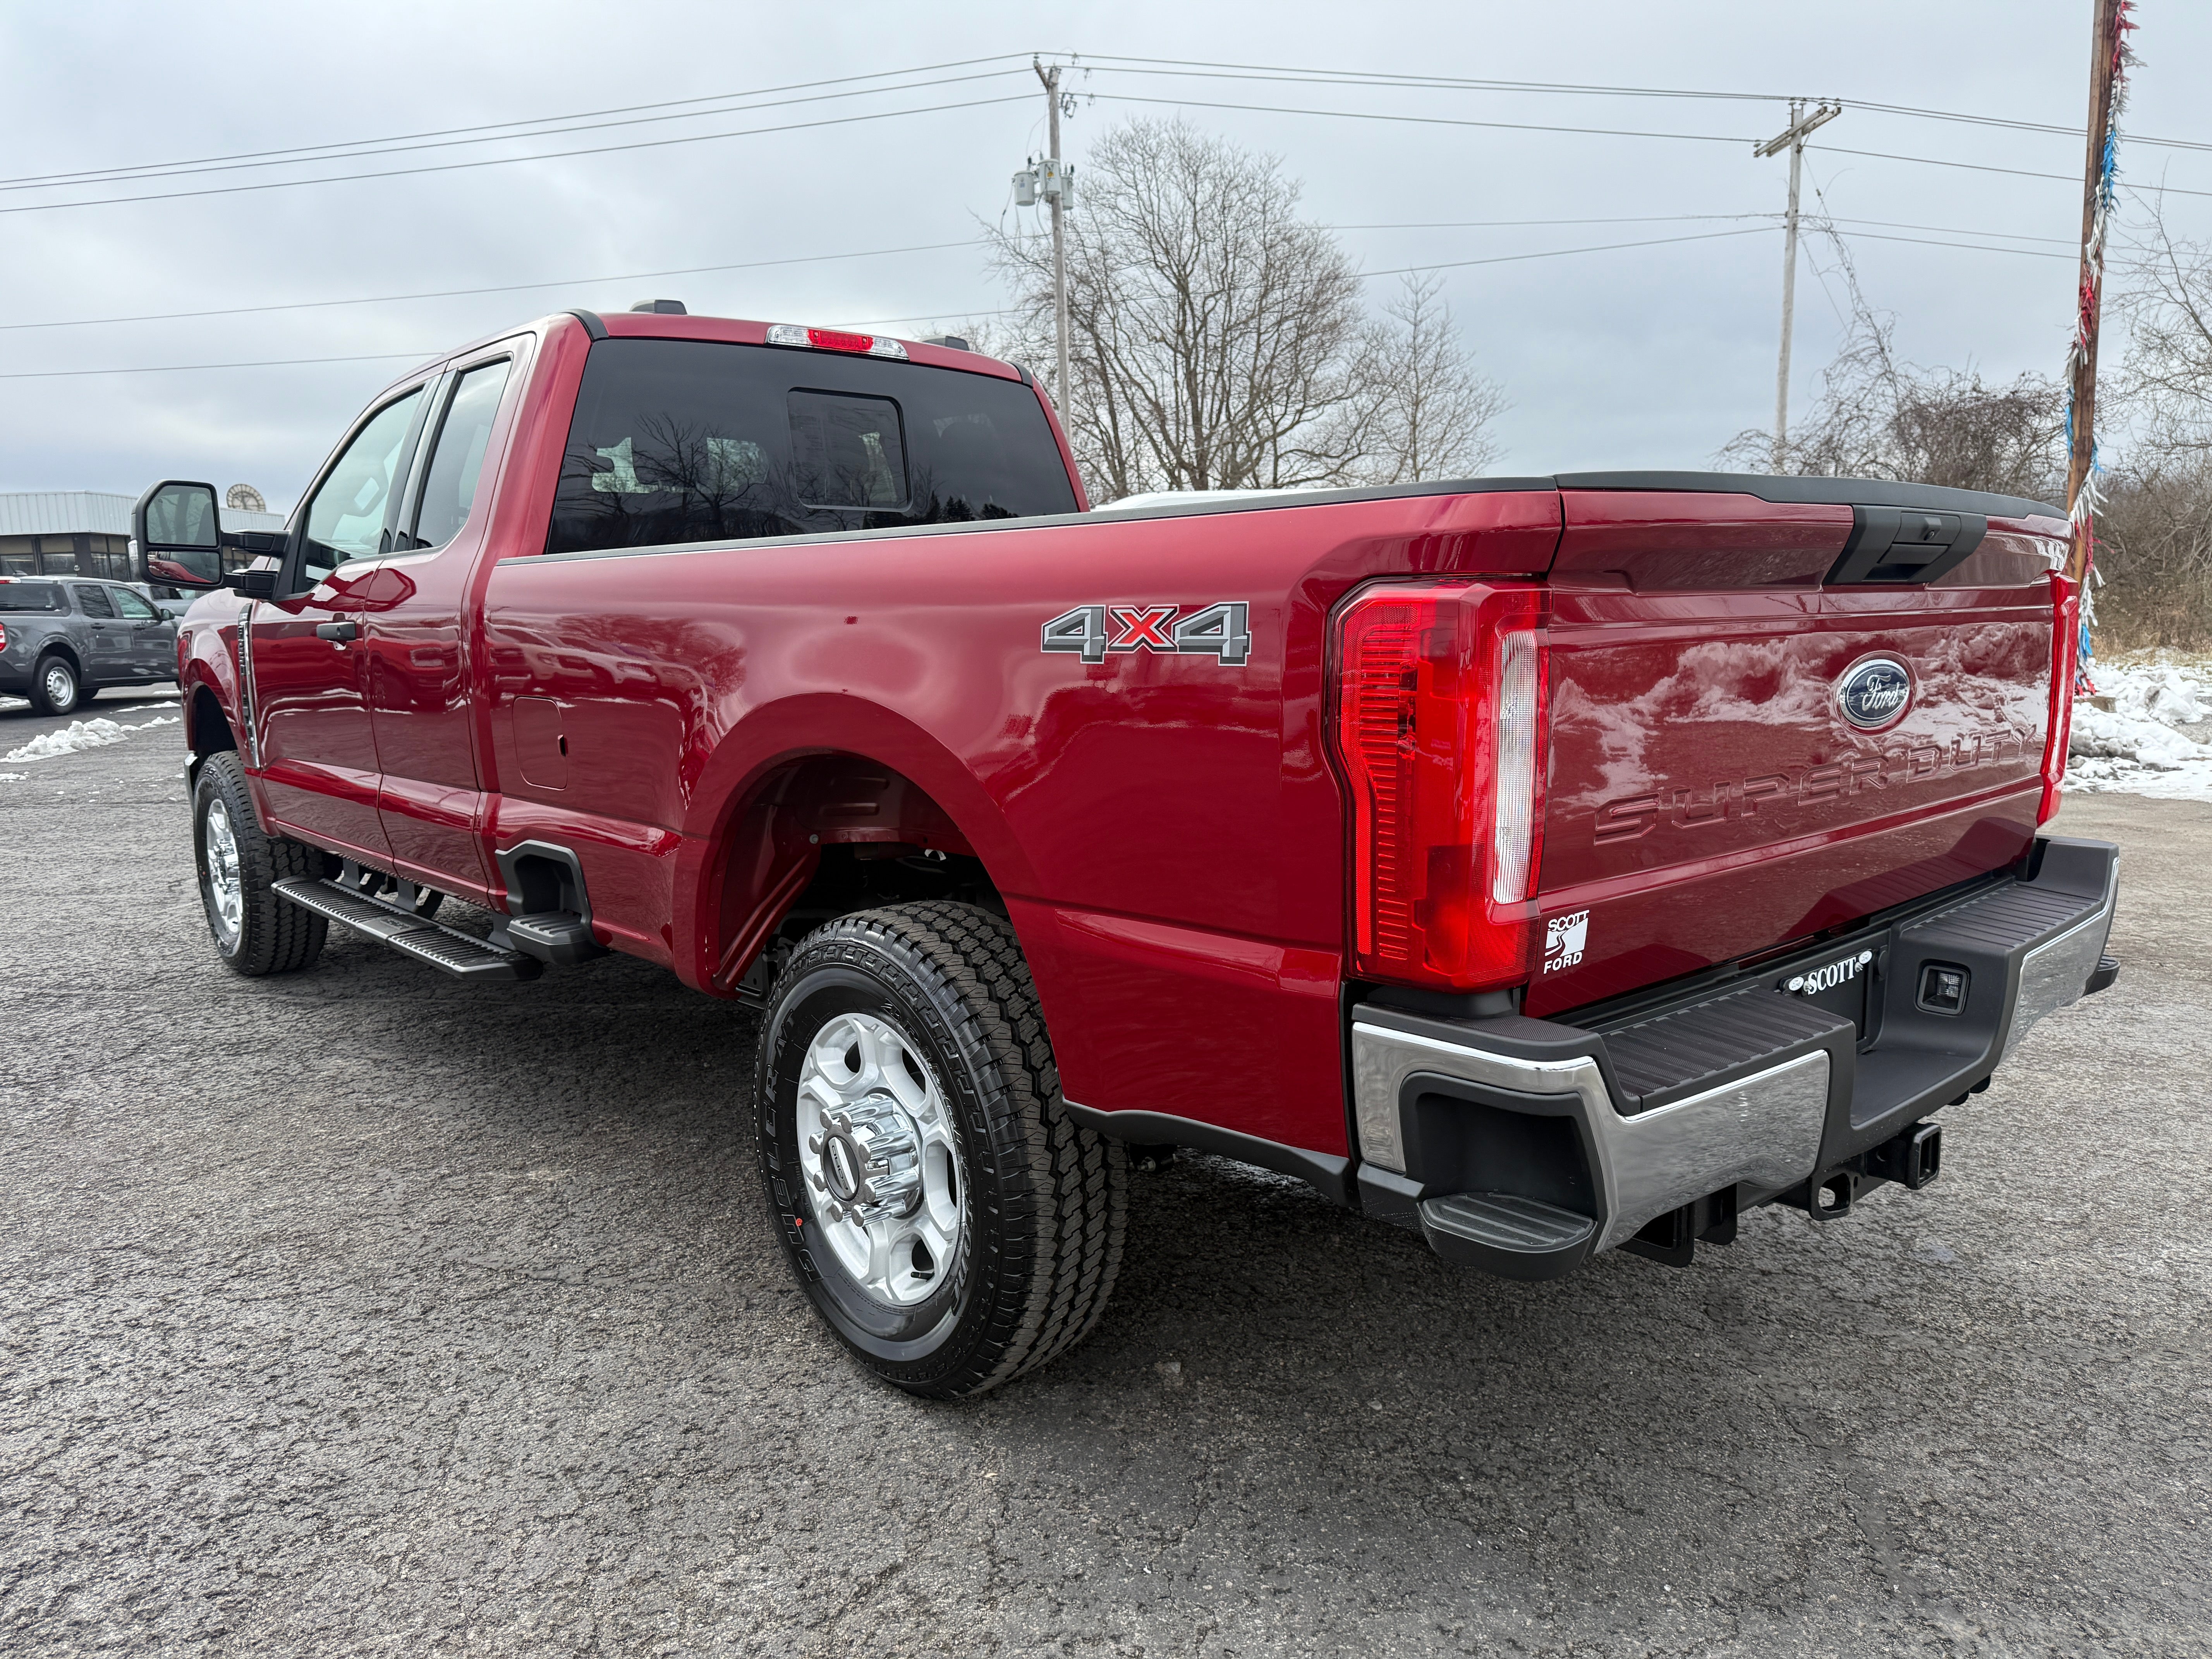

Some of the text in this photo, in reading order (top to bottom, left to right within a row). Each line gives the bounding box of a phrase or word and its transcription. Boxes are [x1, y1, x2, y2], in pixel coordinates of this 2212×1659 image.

[1862, 674, 1901, 711] Ford
[1594, 724, 2037, 846] SUPER DUTY
[1548, 910, 1590, 931] SCOTT
[1544, 951, 1582, 974] FORD
[1808, 957, 1856, 995] SCOTT
